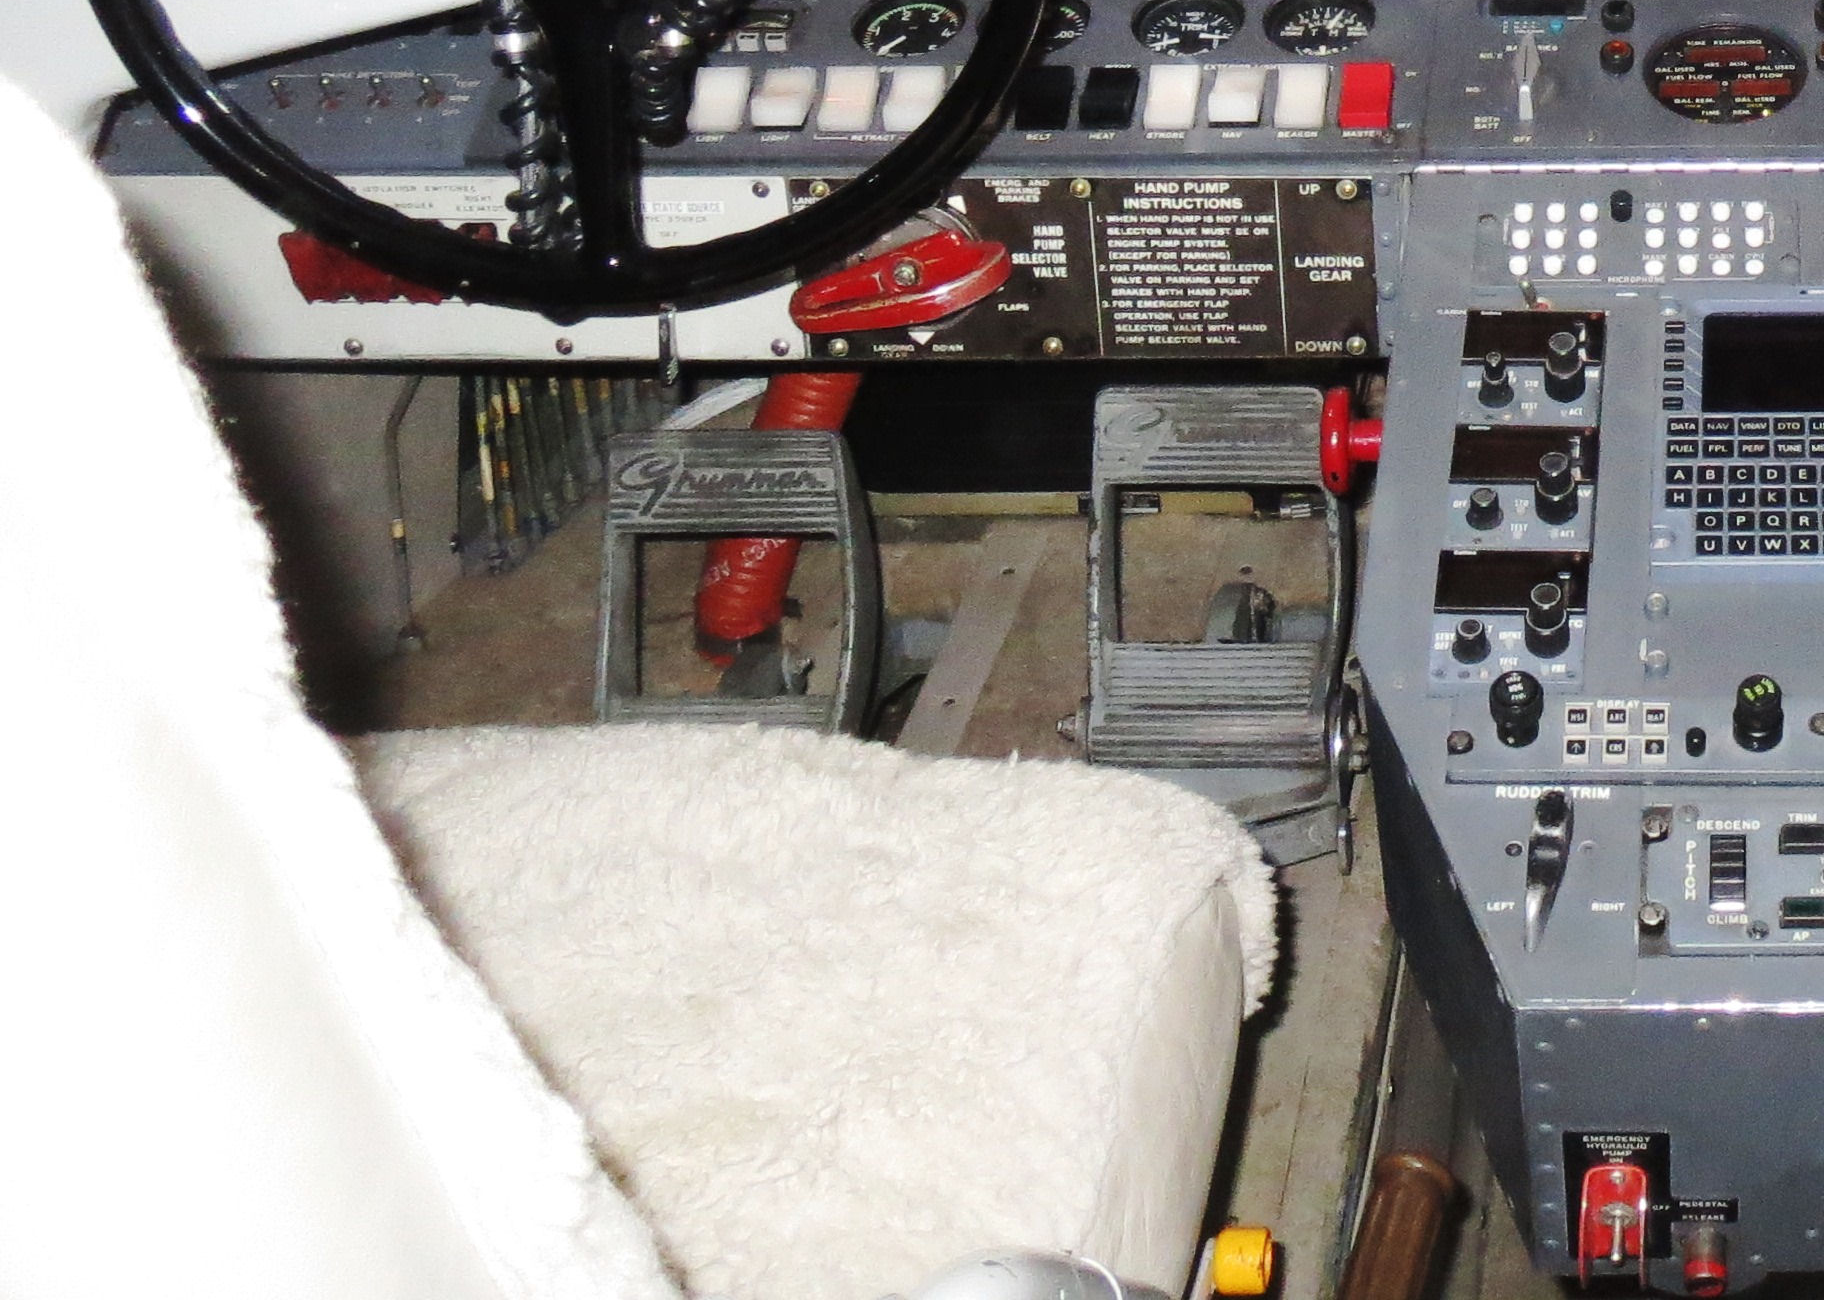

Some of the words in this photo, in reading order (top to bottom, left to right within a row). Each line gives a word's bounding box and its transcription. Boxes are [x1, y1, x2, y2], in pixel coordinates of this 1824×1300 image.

[1135, 183, 1179, 193] HAND
[1184, 182, 1229, 193] PUMP
[1300, 184, 1320, 194] UP
[996, 188, 1040, 198] PARKING
[651, 203, 682, 214] STATIC
[686, 203, 721, 214] SOURCE
[1124, 198, 1242, 209] INSTRUCTIONS
[1216, 215, 1238, 223] NOT
[1254, 215, 1275, 223] USE
[1034, 226, 1063, 236] HAND
[1034, 240, 1064, 249] PUMP
[1012, 253, 1066, 263] SELECTOR
[1295, 257, 1364, 267] LANDING
[1033, 267, 1067, 277] VALVE
[1310, 270, 1351, 281] GEAR
[1296, 341, 1342, 351] DOWN
[1674, 470, 1685, 479] A
[1706, 470, 1715, 479] B
[1737, 469, 1746, 479] C
[1767, 469, 1777, 479] D
[1799, 469, 1806, 479] E
[1674, 493, 1684, 502] H
[1709, 493, 1711, 502] I
[1738, 493, 1745, 502] J
[1768, 492, 1776, 501] K
[1800, 492, 1808, 502] L
[1705, 516, 1716, 526] O
[1737, 516, 1745, 525] P
[1767, 516, 1779, 526] Q
[1800, 516, 1809, 525] R
[1705, 541, 1715, 550] U
[1737, 540, 1746, 550] V
[1765, 539, 1781, 549] W
[1800, 540, 1809, 549] X
[1596, 700, 1640, 709] DISPLAY
[1496, 786, 1564, 799] RUDD
[1570, 787, 1610, 799] TRIM
[1789, 814, 1816, 822] TRIM
[1697, 820, 1760, 830] DESCEND
[1685, 841, 1696, 900] PITCH
[1487, 902, 1514, 911] LEFT
[1592, 903, 1624, 911] RIGHT
[1707, 914, 1748, 924] CLIMB
[1793, 931, 1809, 941] AP
